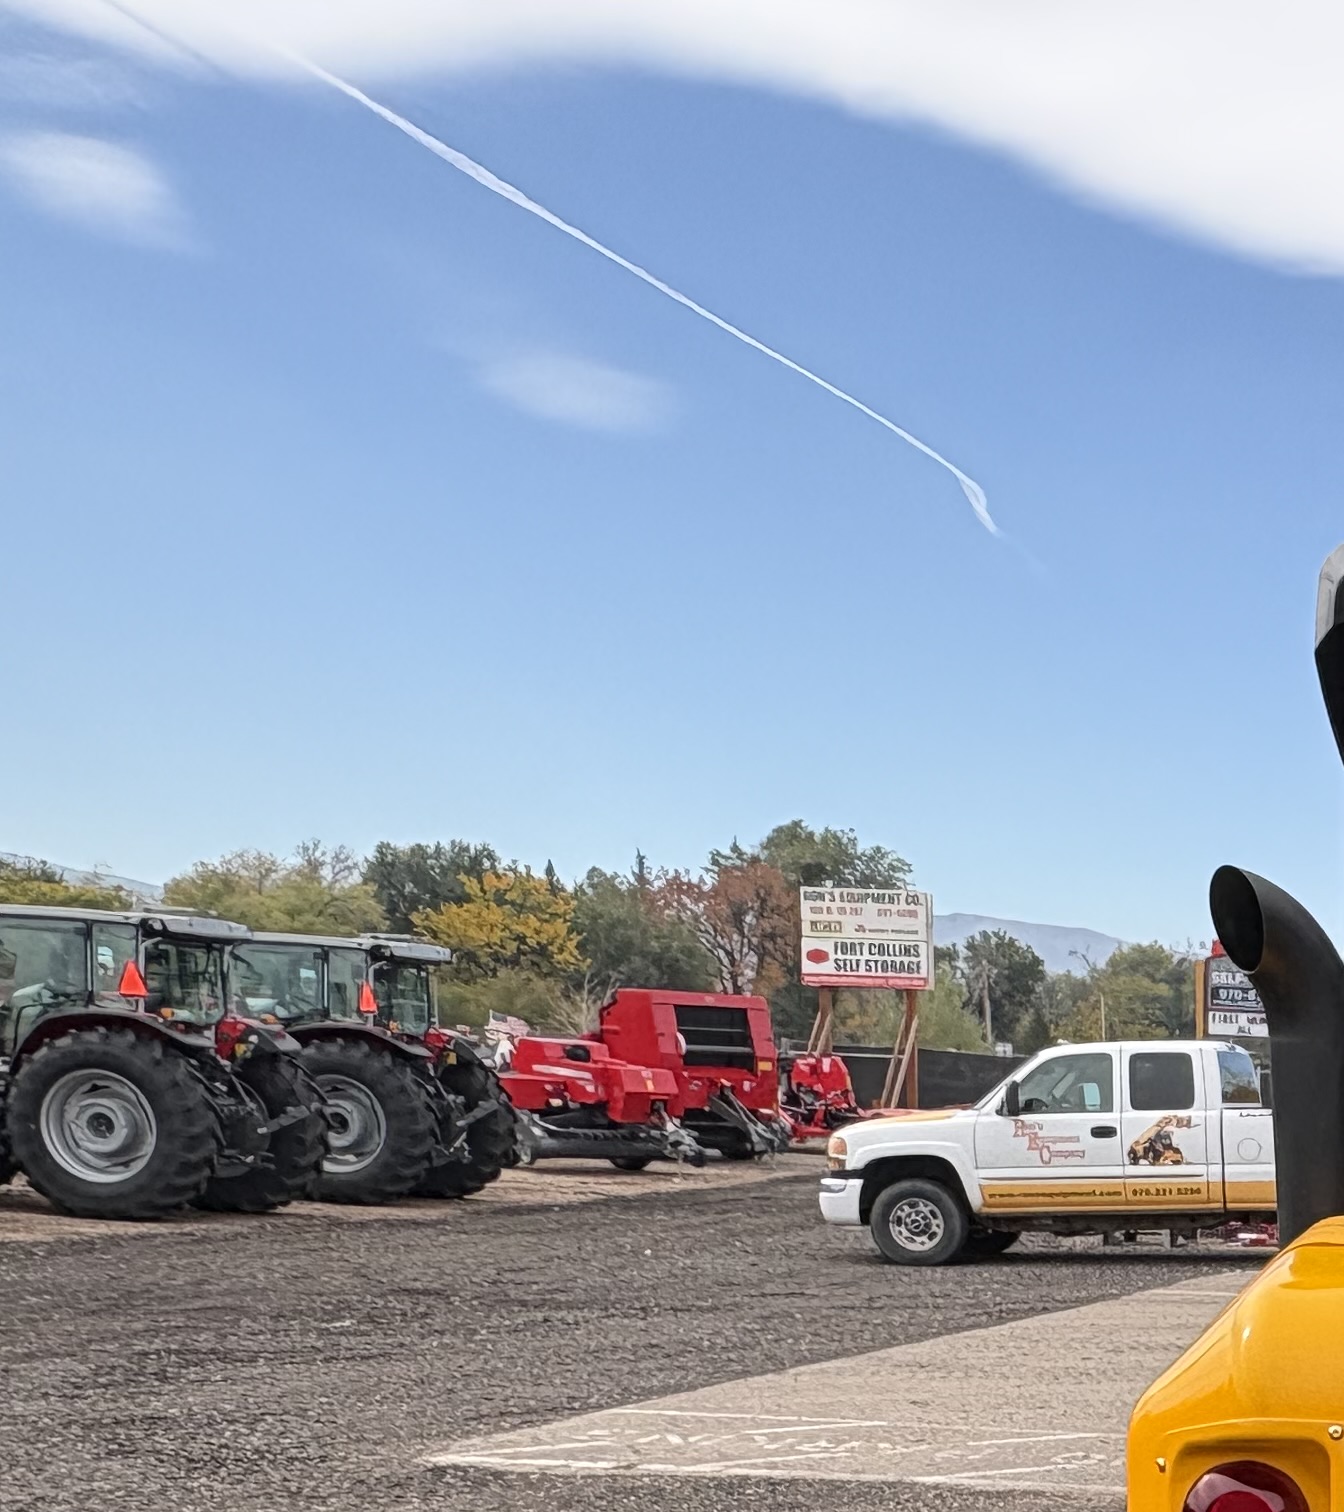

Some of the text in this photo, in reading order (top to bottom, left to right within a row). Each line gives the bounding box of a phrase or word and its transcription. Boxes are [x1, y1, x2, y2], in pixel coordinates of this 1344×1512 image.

[833, 941, 920, 958] FORT COLLINS
[834, 958, 921, 975] SELF STORAGE
